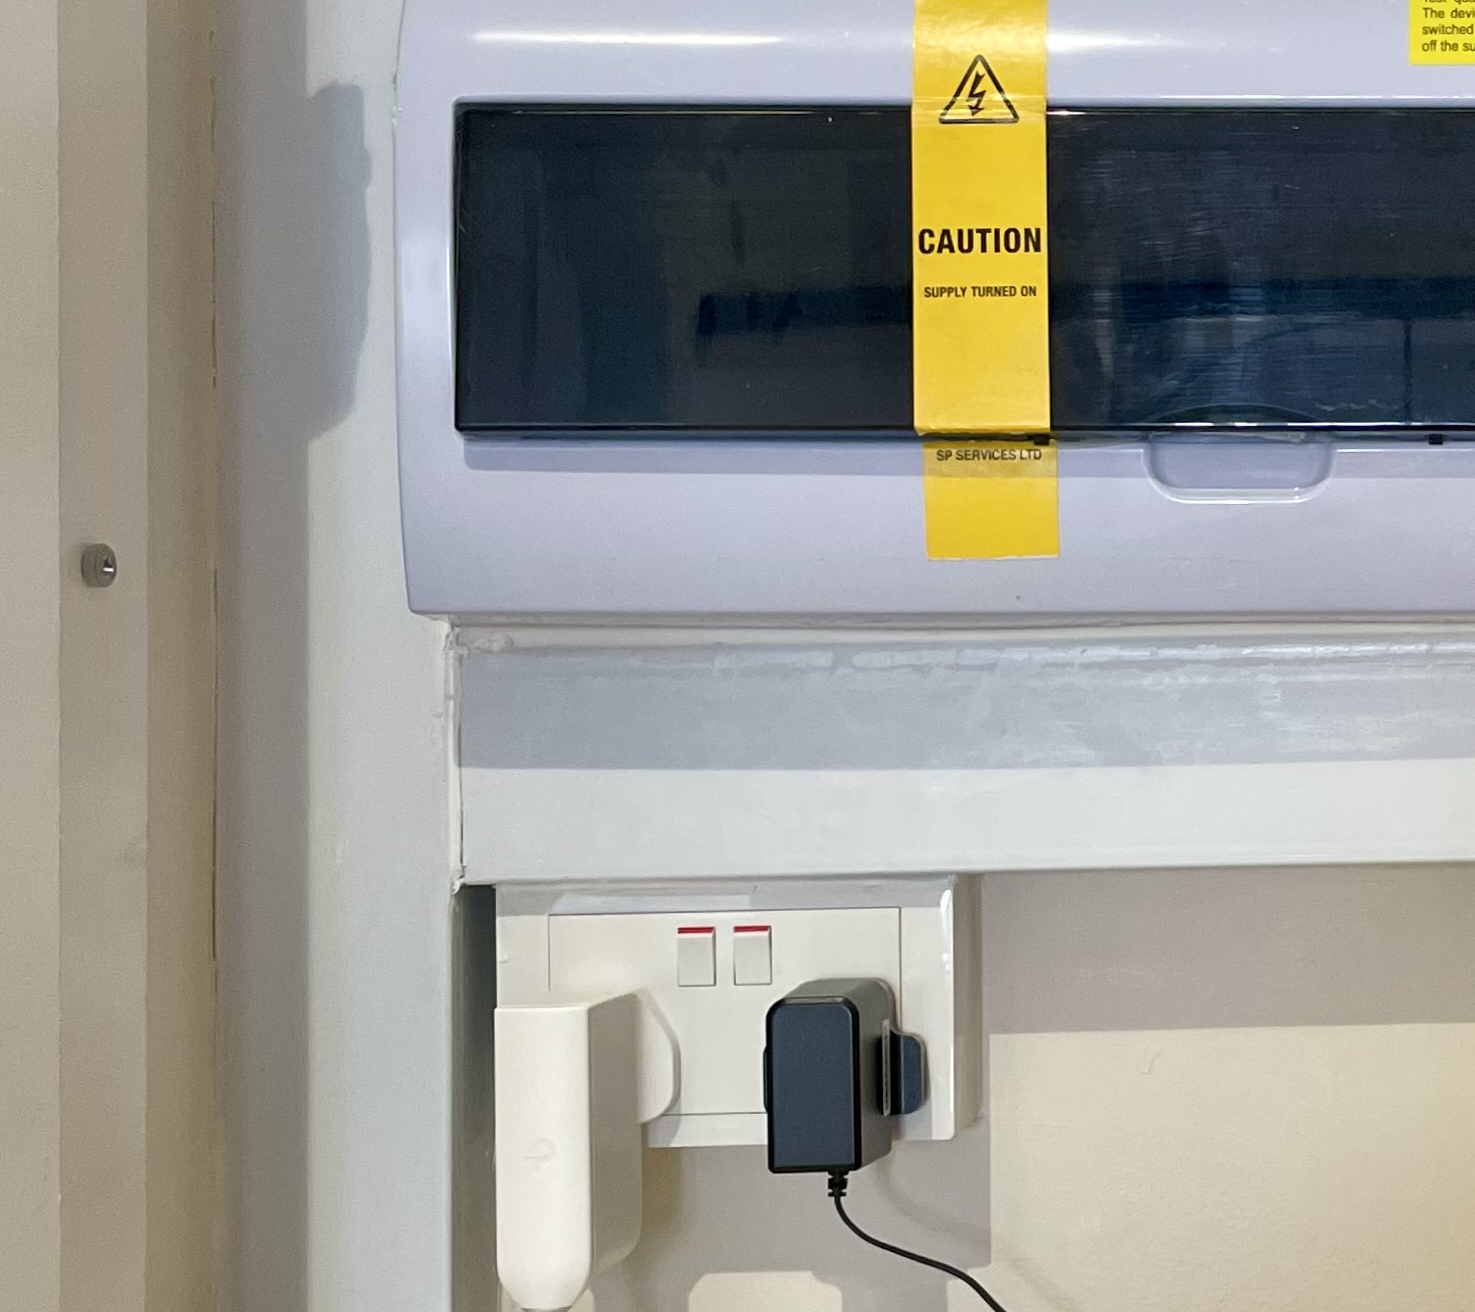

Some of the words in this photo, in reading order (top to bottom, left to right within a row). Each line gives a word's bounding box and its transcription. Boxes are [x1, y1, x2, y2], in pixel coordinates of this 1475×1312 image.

[1422, 7, 1445, 19] The
[1422, 24, 1474, 35] switched
[1422, 40, 1437, 52] off
[1440, 40, 1459, 52] the
[918, 227, 1041, 254] CAUTION
[924, 286, 967, 298] SUPPLY
[971, 286, 1017, 297] TURNED
[1020, 285, 1037, 297] ON
[936, 449, 953, 461] SP
[955, 449, 1017, 461] SERVICES
[1019, 449, 1042, 460] LTD
